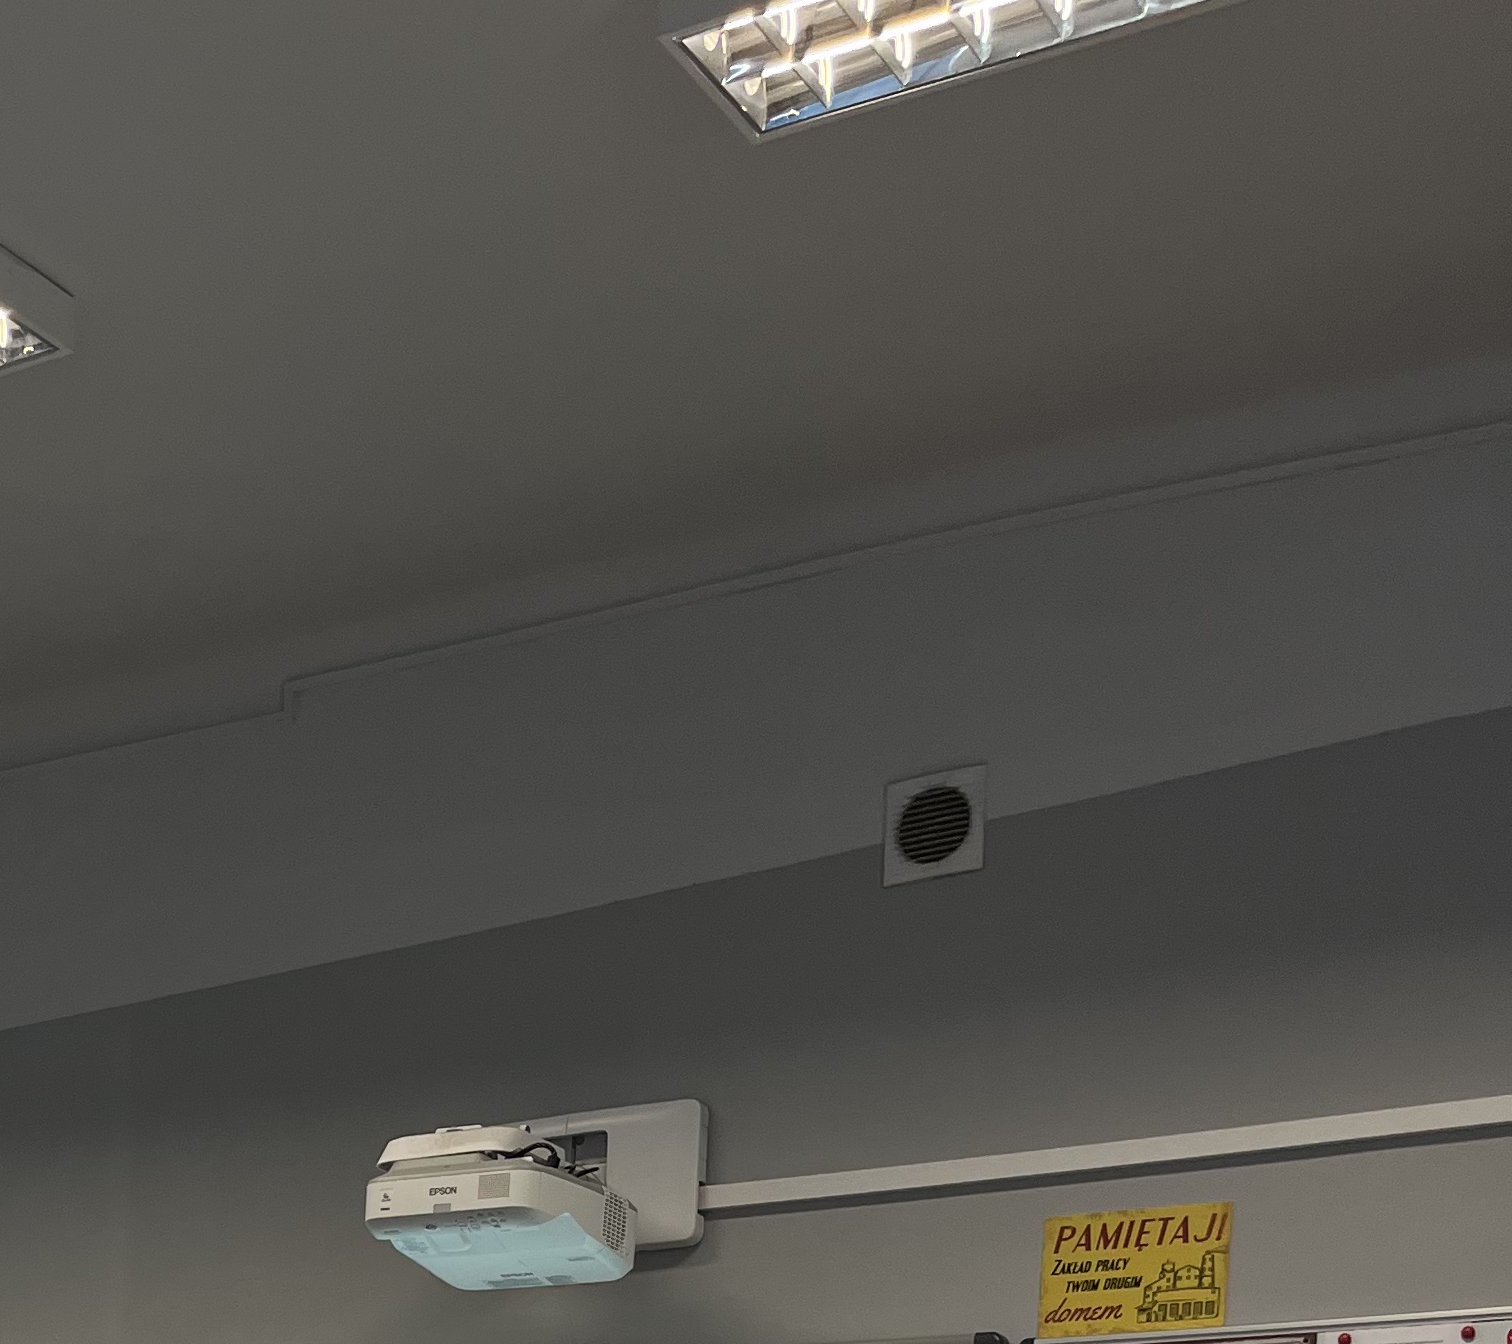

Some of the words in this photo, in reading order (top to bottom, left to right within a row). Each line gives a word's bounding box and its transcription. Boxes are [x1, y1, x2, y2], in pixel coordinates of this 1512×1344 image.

[429, 1186, 457, 1196] EPSON
[1095, 1257, 1131, 1273] PRACY
[1044, 1298, 1124, 1325] domem
